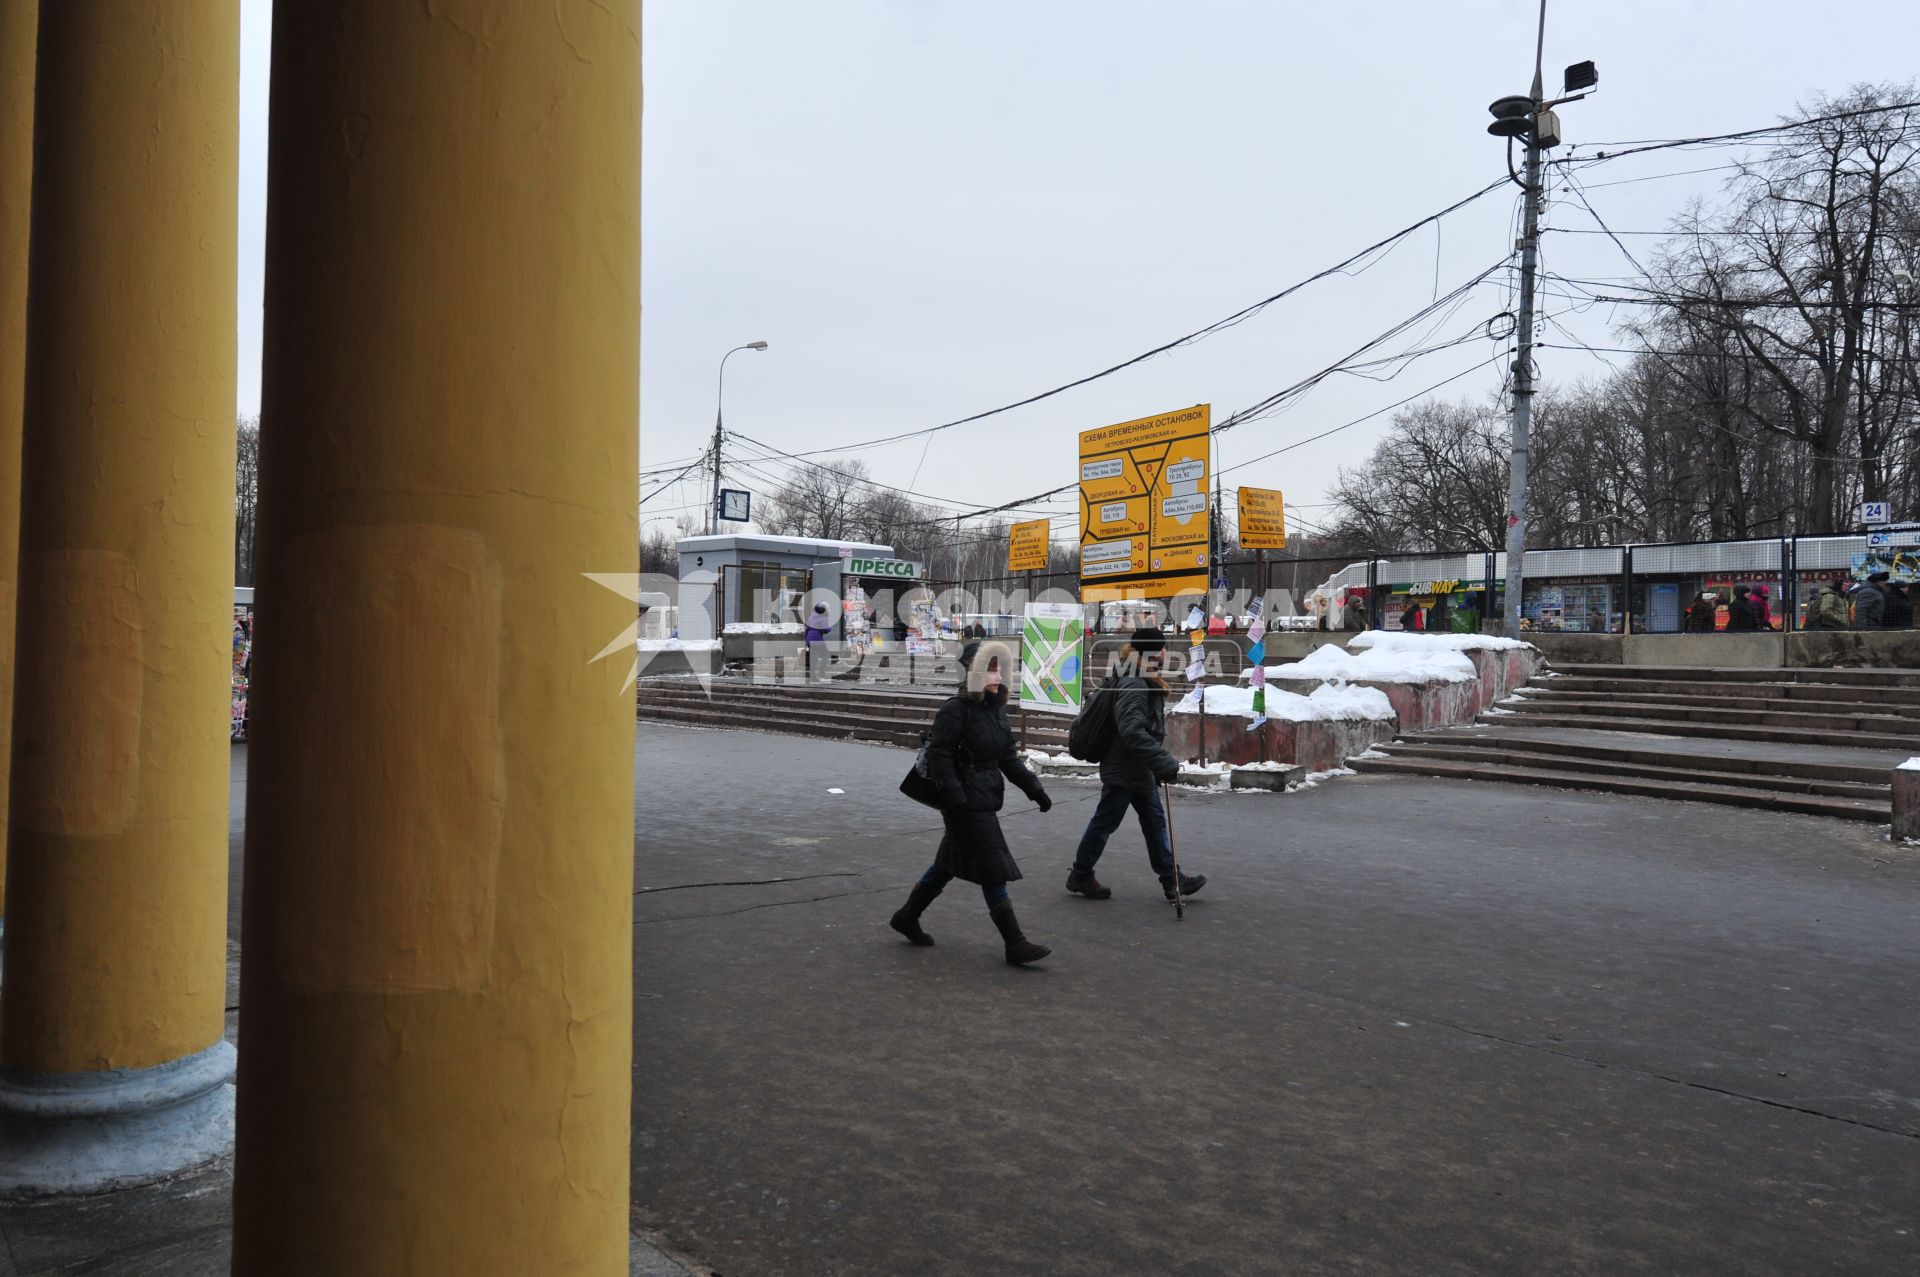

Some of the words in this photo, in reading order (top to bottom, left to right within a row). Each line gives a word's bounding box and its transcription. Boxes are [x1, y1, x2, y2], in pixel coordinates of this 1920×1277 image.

[1084, 431, 1107, 444] СХЕМА
[1108, 420, 1154, 438] ВРЕМЕННЫХ
[1155, 410, 1203, 428] ОСТАНОВОК
[1866, 504, 1882, 517] 24
[850, 558, 914, 577] ПРЕССА
[1408, 579, 1459, 595] SUBWAY
